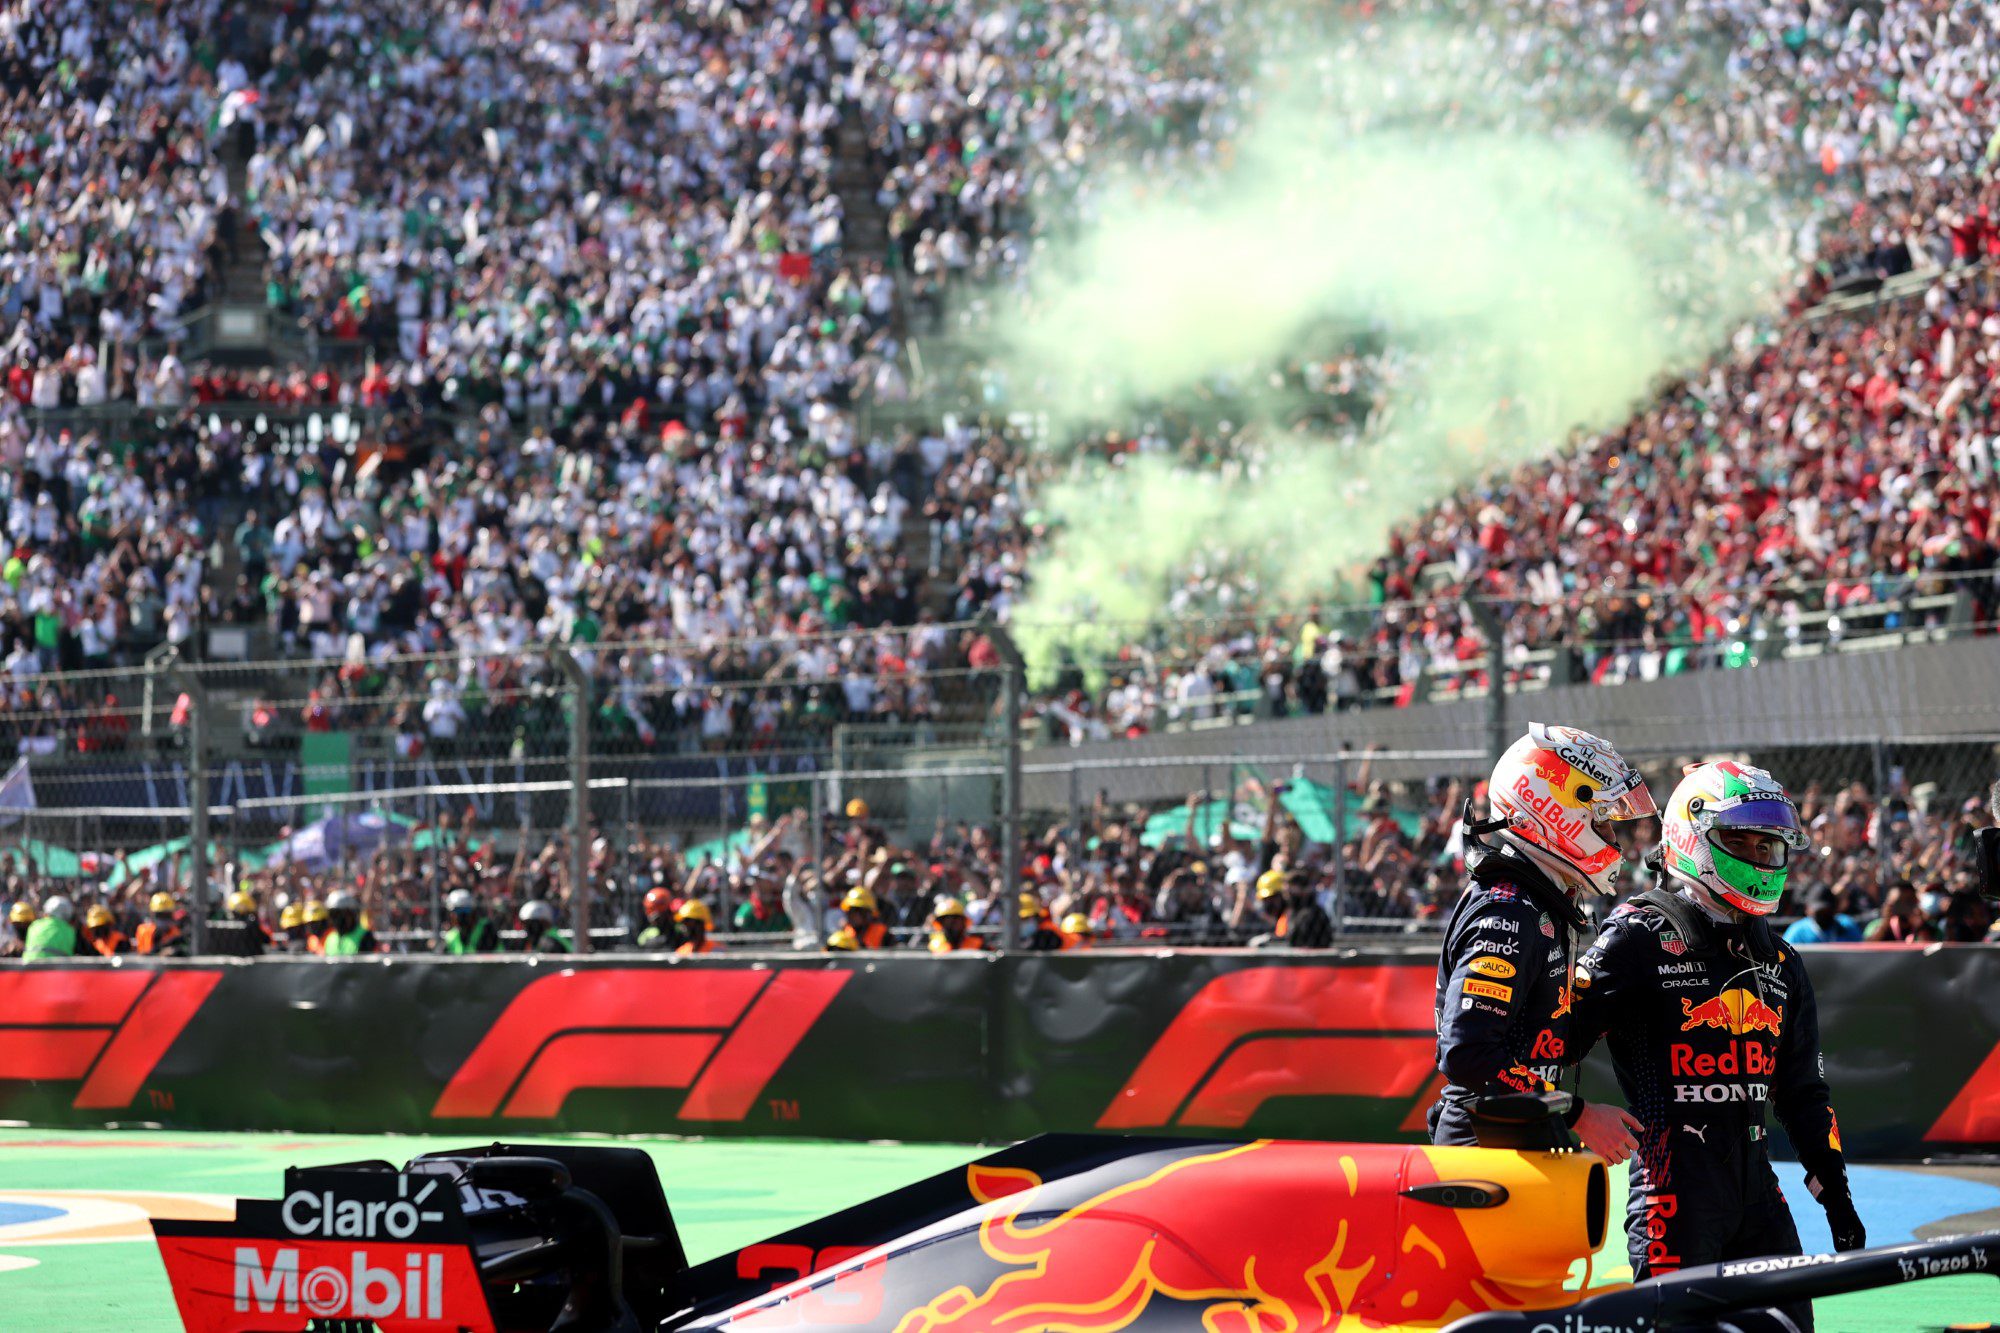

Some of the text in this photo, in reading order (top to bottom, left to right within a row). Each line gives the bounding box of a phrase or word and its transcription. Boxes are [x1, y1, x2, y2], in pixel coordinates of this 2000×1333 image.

[1560, 747, 1613, 787] CarNext
[1512, 774, 1585, 841] Red Bull
[1746, 792, 1795, 806] HOND
[1479, 917, 1519, 934] Mobil
[1661, 932, 1682, 941] TA
[1473, 938, 1518, 956] Claro
[1480, 960, 1511, 975] RAUCH
[1658, 962, 1694, 975] Mobil
[1467, 982, 1509, 999] PIRELLI
[1662, 978, 1710, 989] ORACLE
[1475, 1001, 1508, 1017] Cash App
[1530, 1028, 1565, 1060] Re
[1670, 1040, 1740, 1077] Red
[1497, 1069, 1517, 1088] Red
[1674, 1083, 1769, 1103] HOND
[770, 1100, 799, 1120] TM
[282, 1179, 440, 1239] Claro
[1645, 1194, 1681, 1264] Red
[1722, 1253, 1840, 1278] HONDA
[1920, 1256, 1970, 1276] Tezos
[233, 1246, 443, 1320] Mobil
